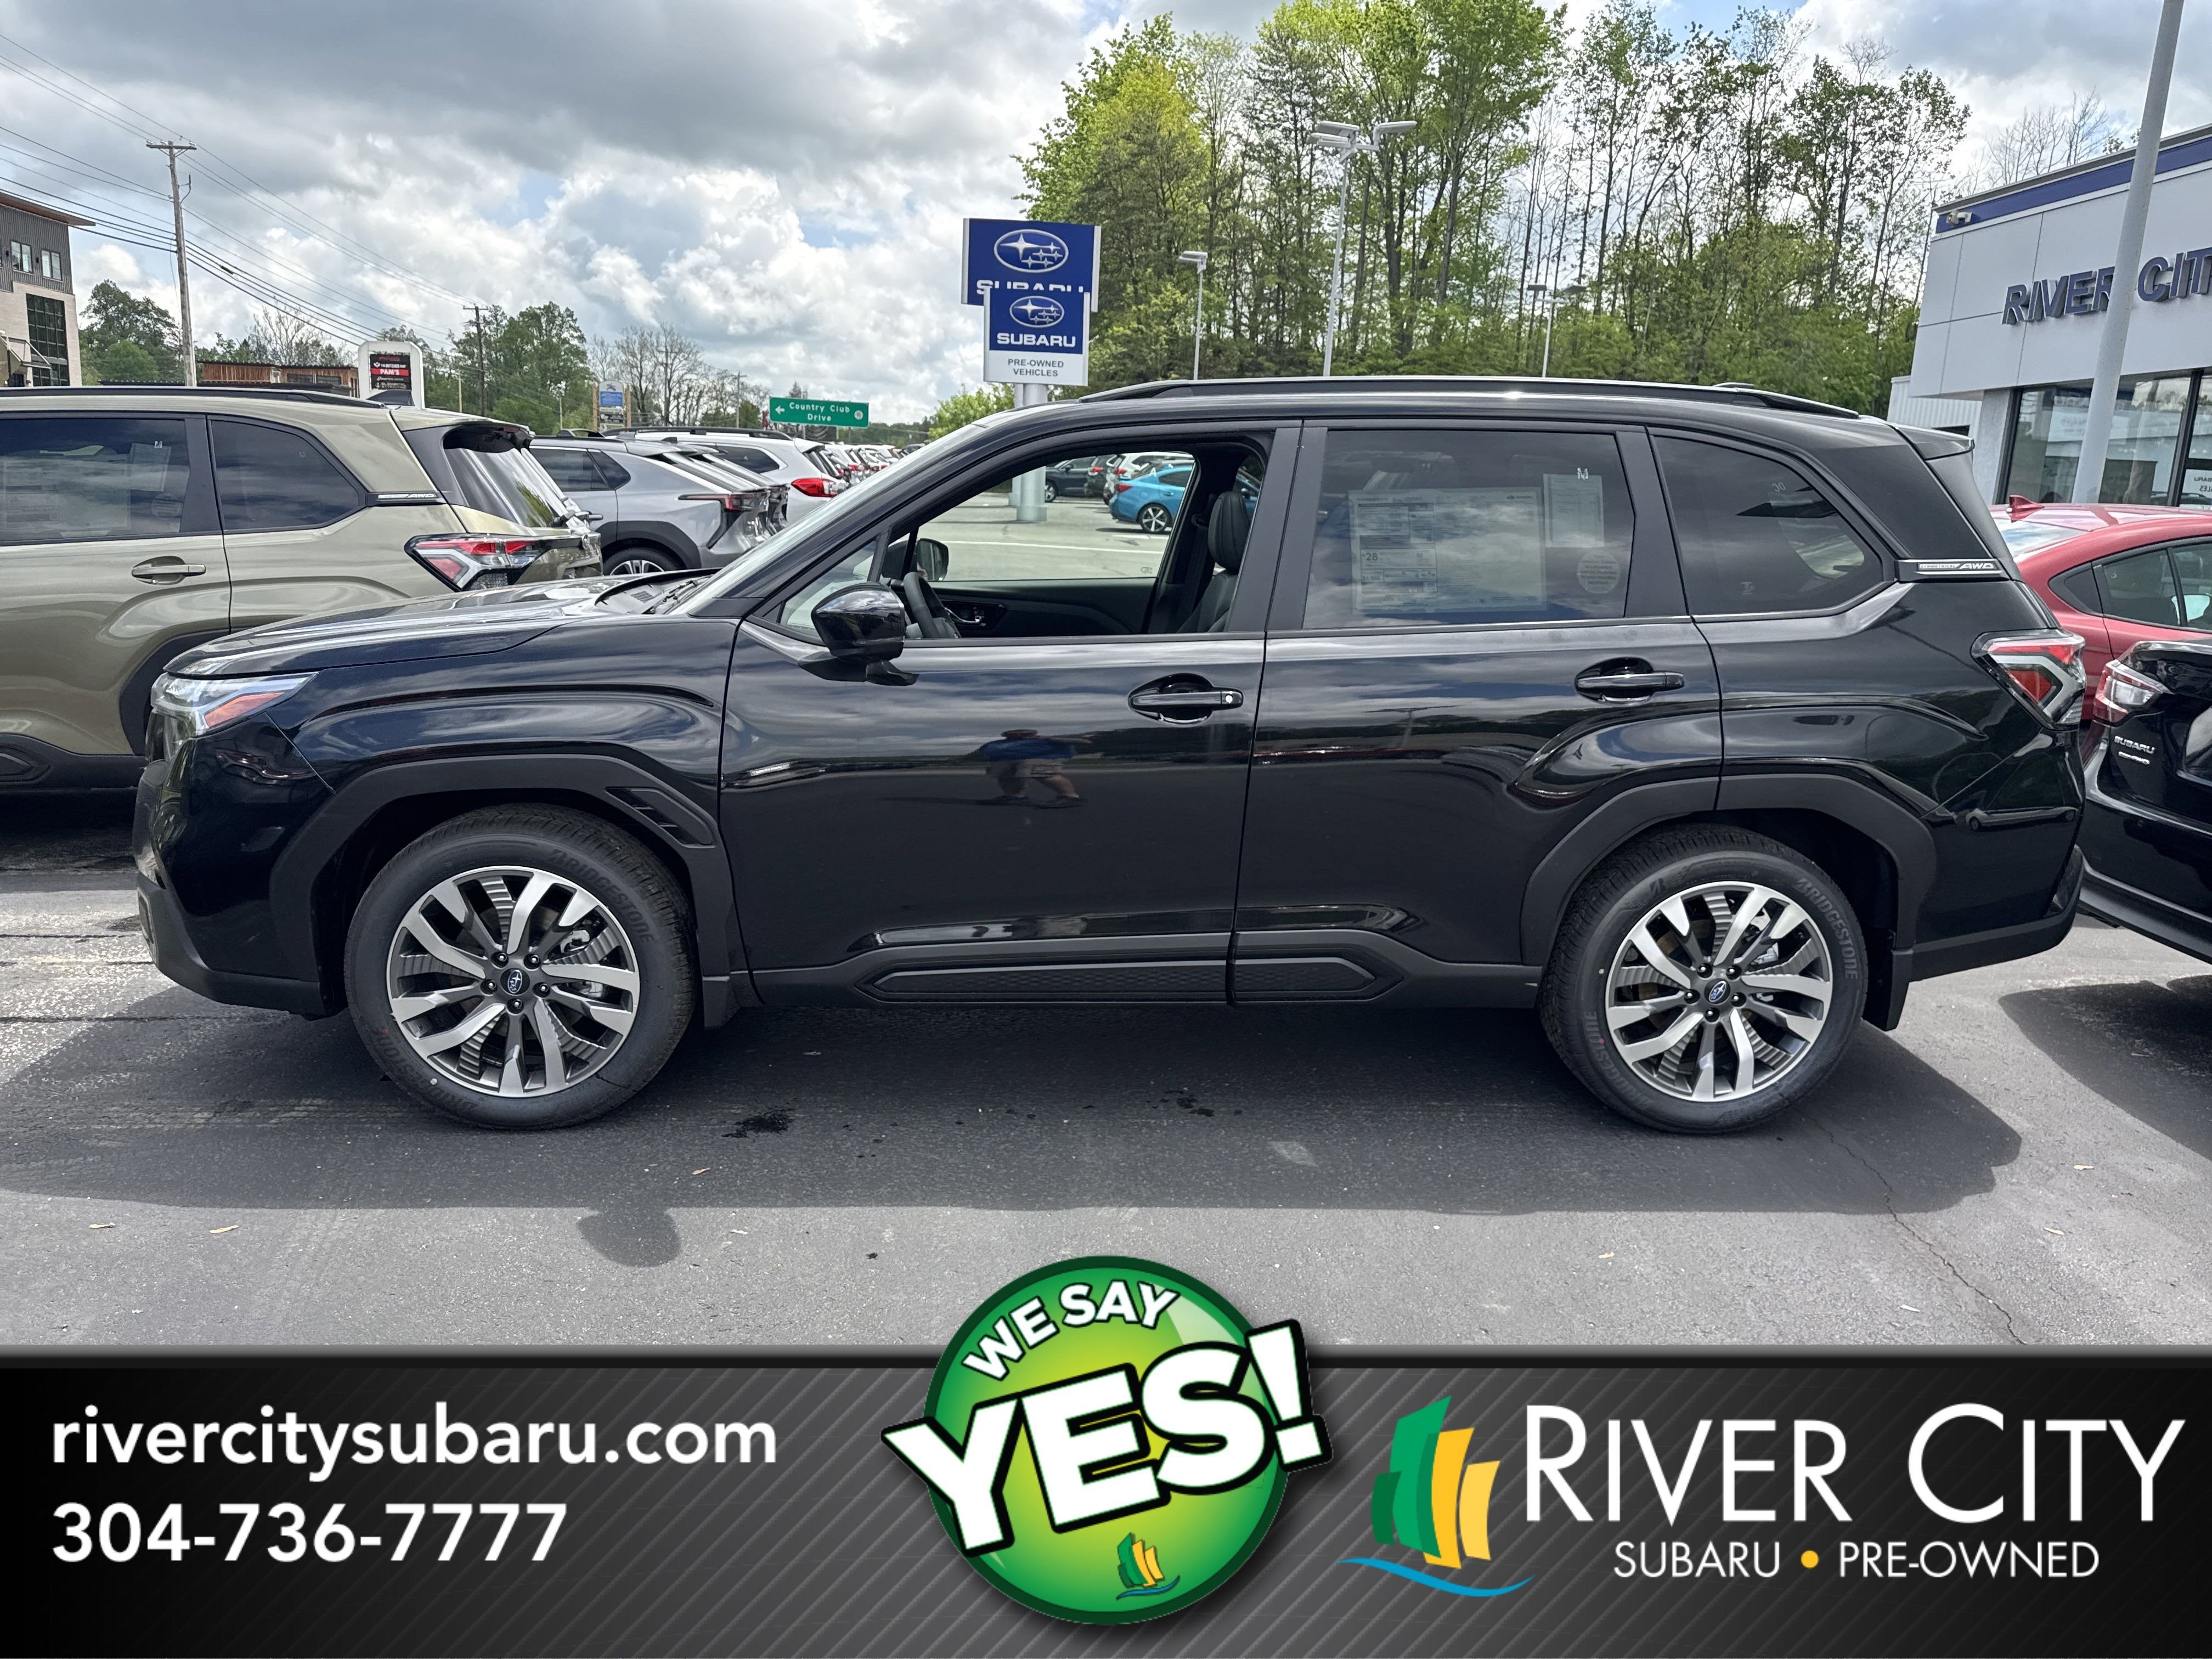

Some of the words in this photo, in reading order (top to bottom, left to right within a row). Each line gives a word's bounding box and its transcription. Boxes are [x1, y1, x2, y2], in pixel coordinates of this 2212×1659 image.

[2002, 266, 2115, 325] RIVER
[997, 332, 1076, 347] SUBARU
[1008, 359, 1064, 368] PRE-OWNED
[1013, 368, 1058, 377] VEHICLES
[789, 402, 825, 413] Country
[830, 404, 850, 413] Club
[807, 413, 832, 422] Drive
[1366, 552, 1378, 561] 28
[2114, 736, 2155, 754] SUBARU
[546, 849, 654, 944] BRIDGESTONE
[1792, 877, 1859, 980] BRIDGESTONE
[1584, 1011, 1655, 1110] BRIDGESTONE
